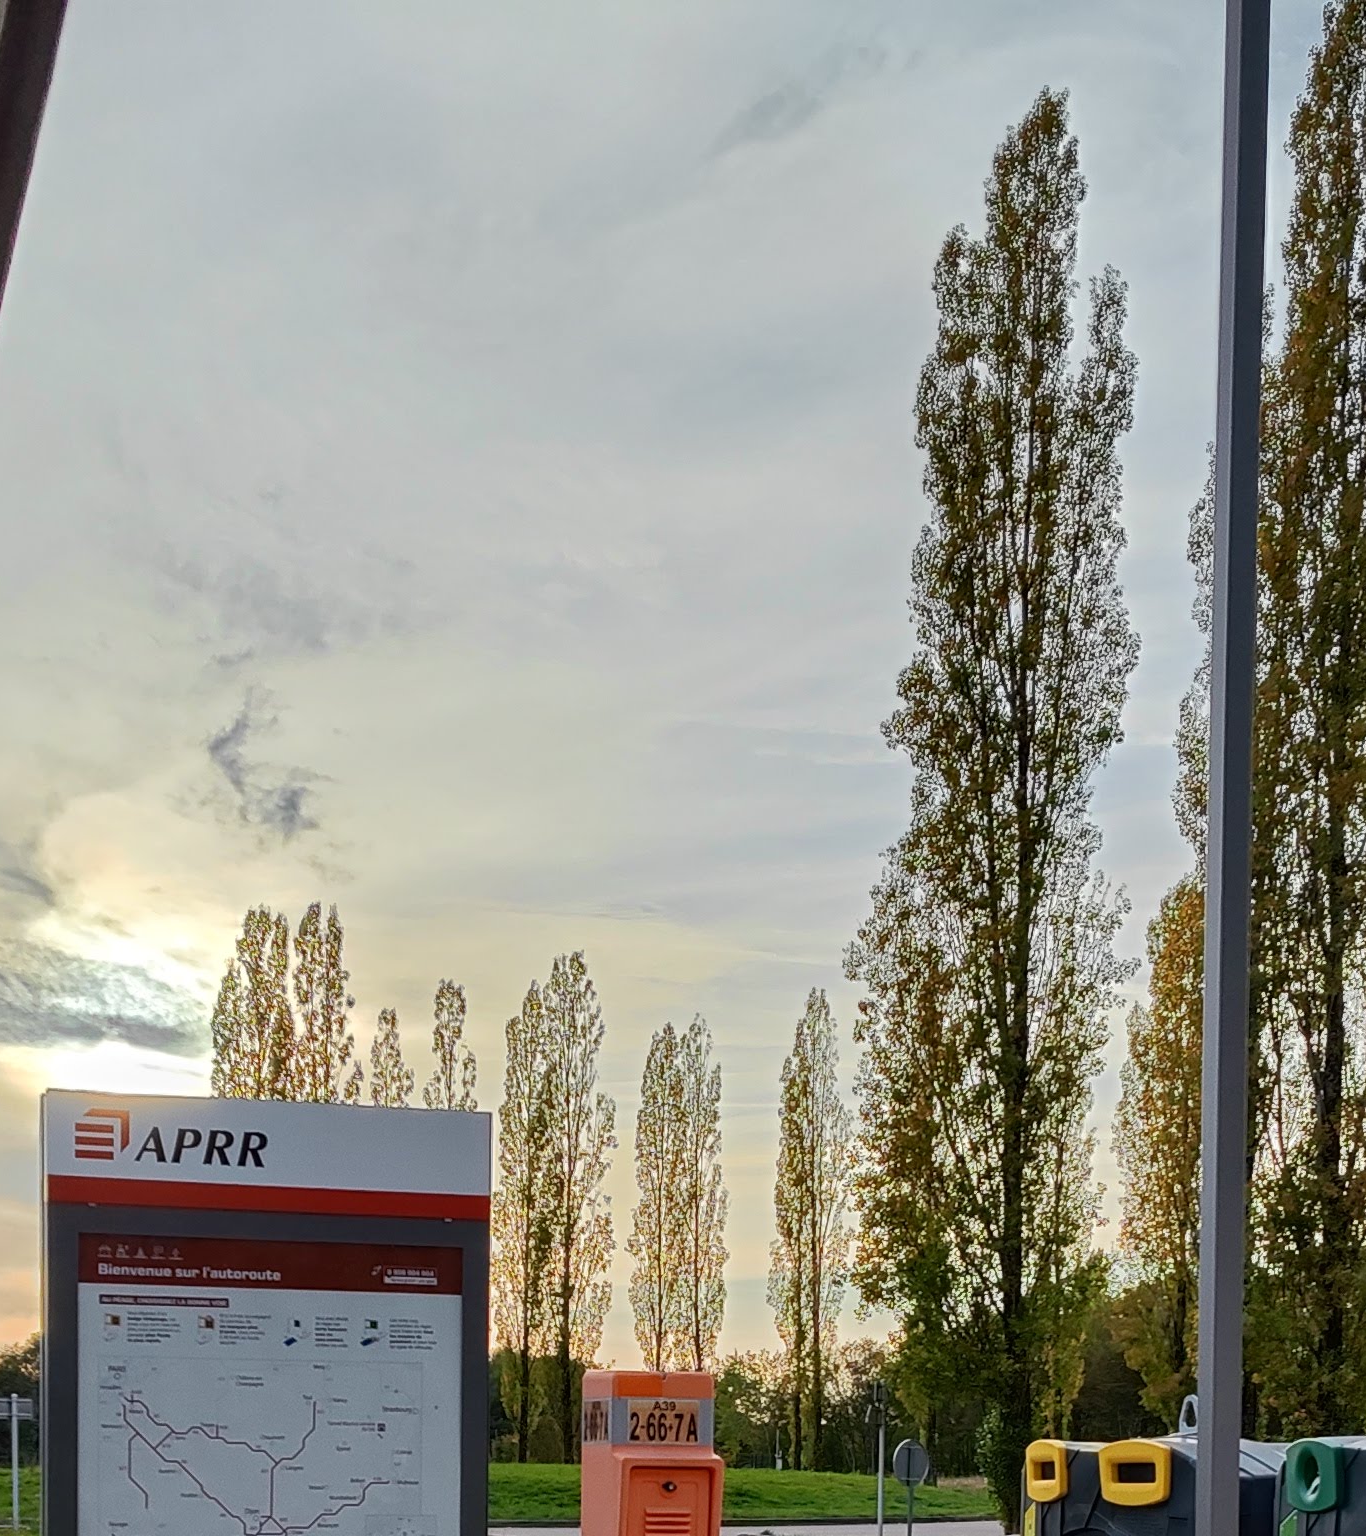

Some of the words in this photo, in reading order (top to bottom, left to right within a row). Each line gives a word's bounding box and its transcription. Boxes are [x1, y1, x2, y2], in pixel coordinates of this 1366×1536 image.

[135, 1126, 269, 1168] APRR
[98, 1263, 172, 1277] Bienvenue
[175, 1267, 200, 1278] sur
[202, 1266, 282, 1281] l'autoroute
[652, 1401, 676, 1411] A39
